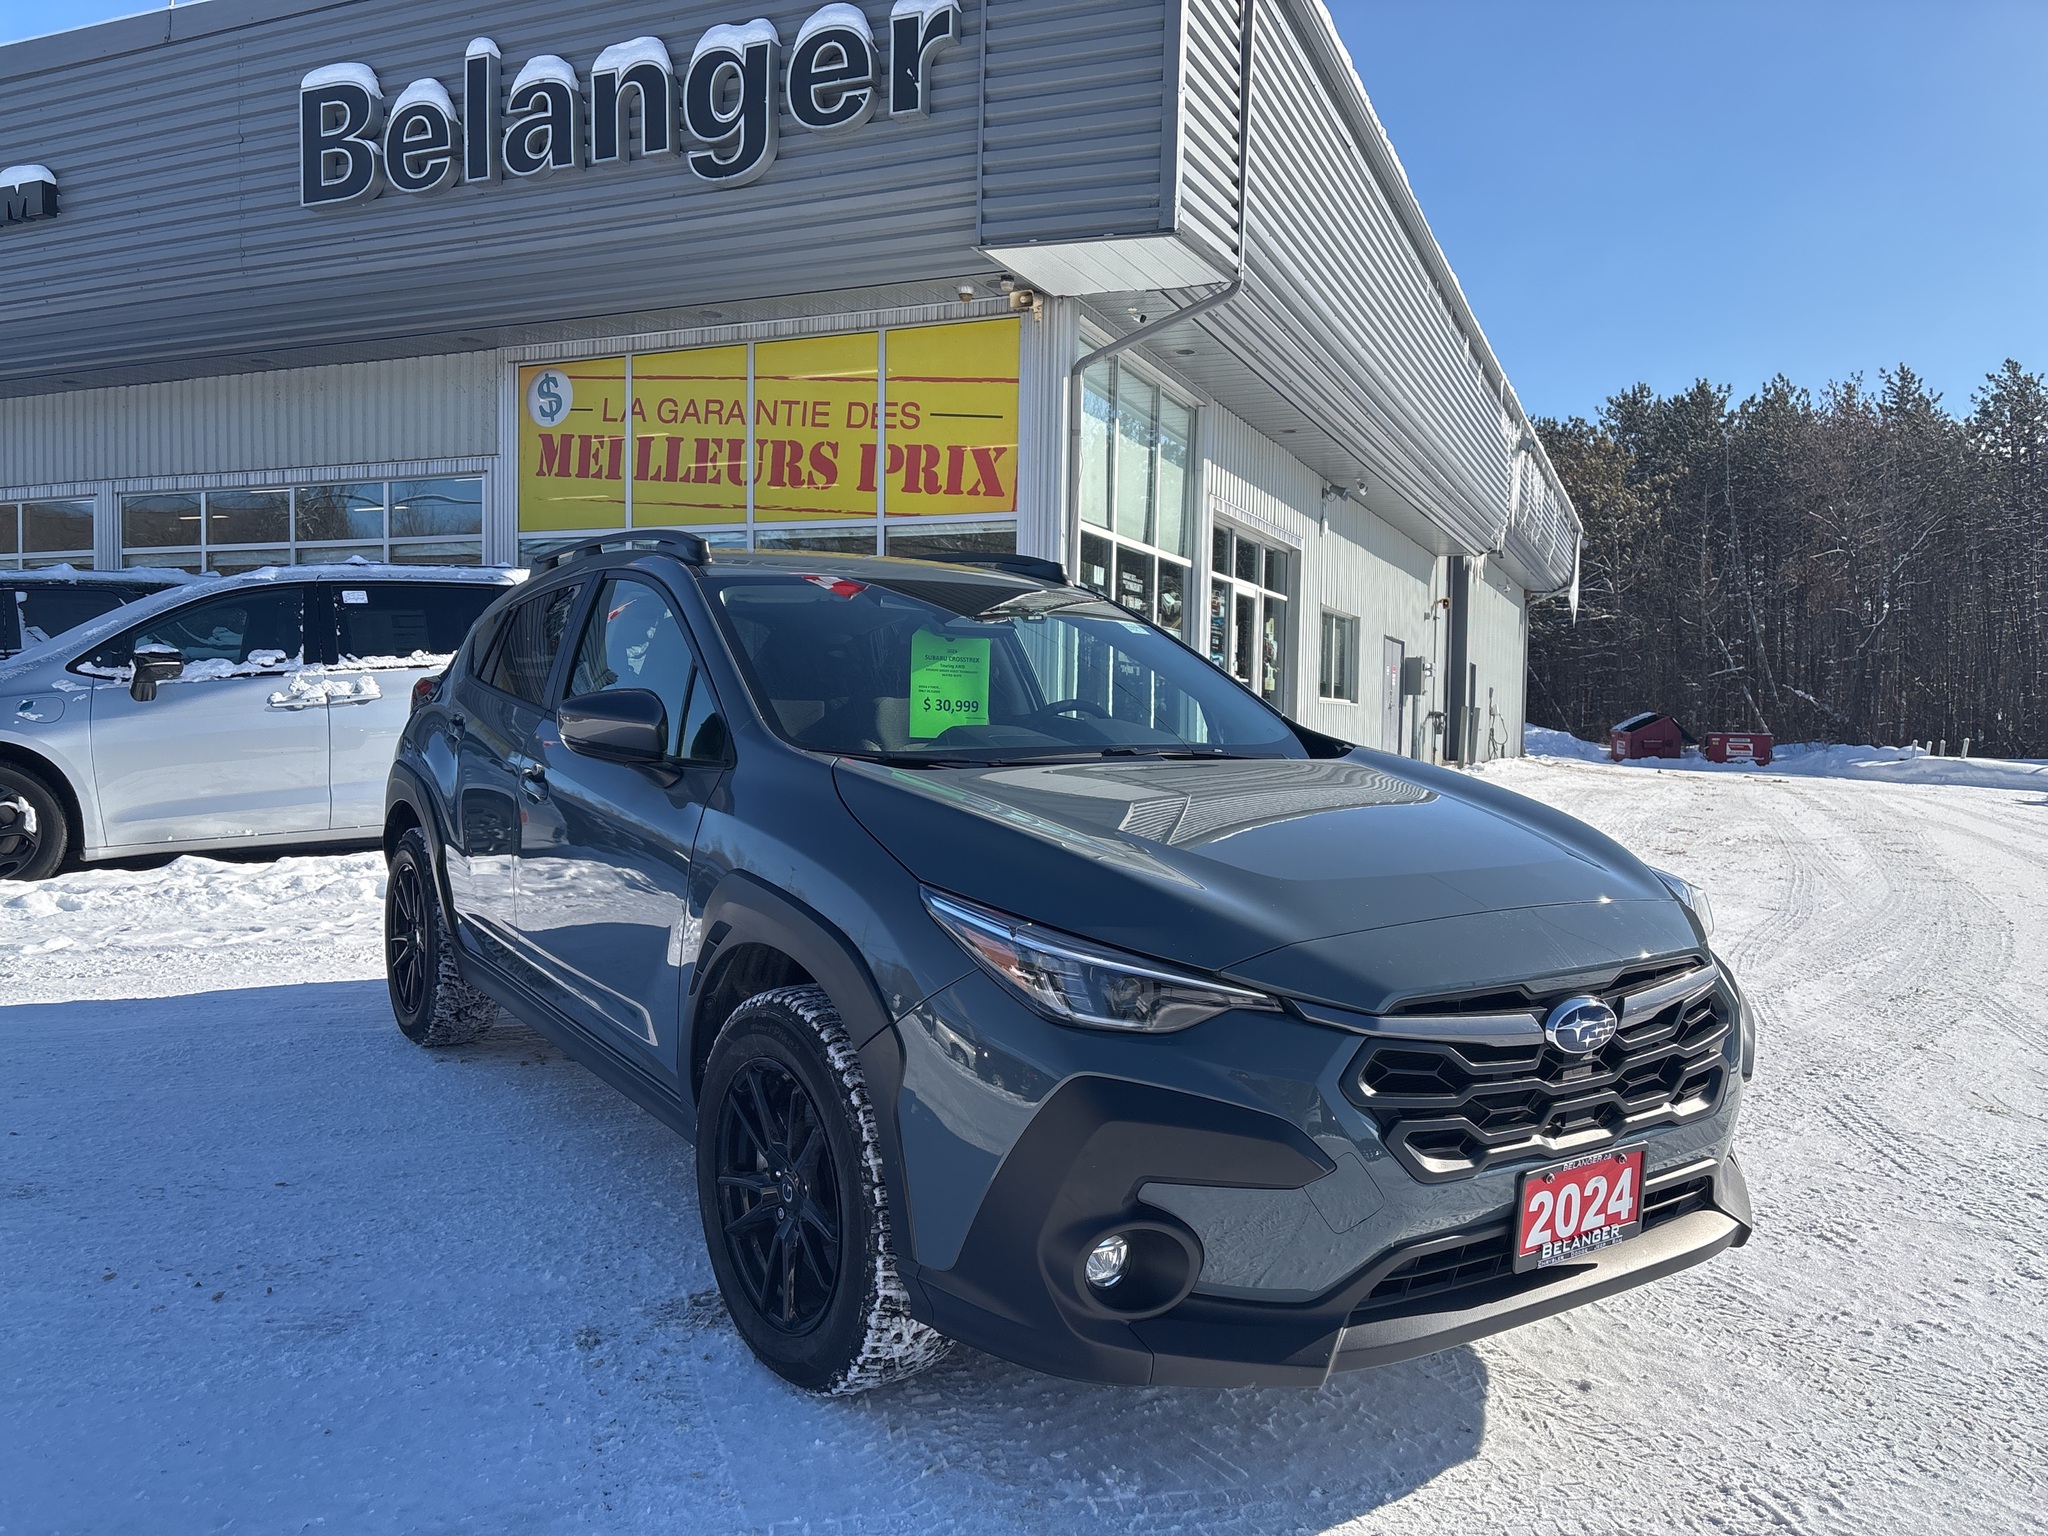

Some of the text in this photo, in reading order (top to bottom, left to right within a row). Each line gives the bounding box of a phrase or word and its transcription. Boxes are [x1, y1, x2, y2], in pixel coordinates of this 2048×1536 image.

[301, 4, 959, 208] Belanger
[602, 397, 921, 430] LA GARANTIE DES
[535, 432, 1008, 498] MEILLEURS PRIX
[923, 697, 979, 714] $ 30,999
[1525, 1167, 1633, 1249] 2024
[1541, 1223, 1620, 1259] BELANGER
